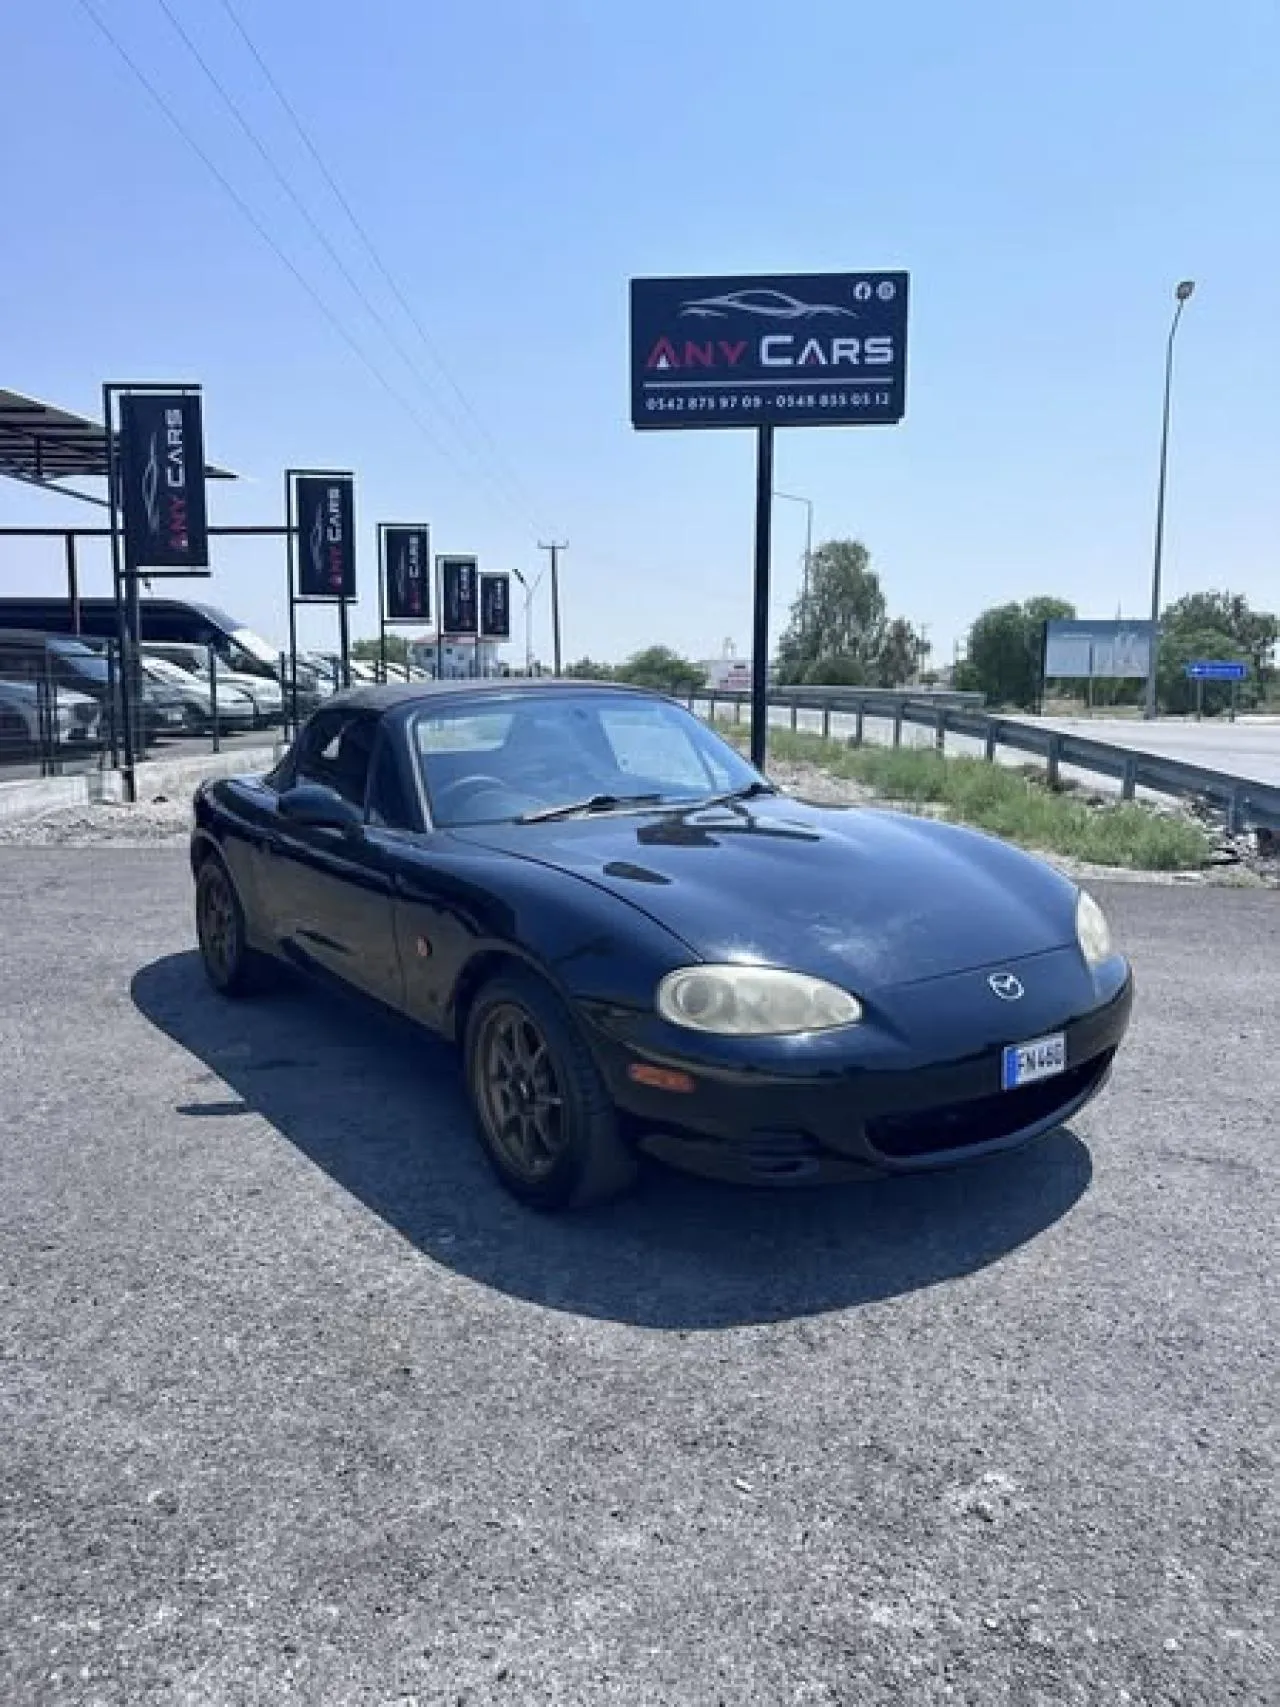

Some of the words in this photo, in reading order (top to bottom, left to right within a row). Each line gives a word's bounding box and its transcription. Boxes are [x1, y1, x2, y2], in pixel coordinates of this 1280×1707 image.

[646, 336, 748, 369] ANY
[760, 335, 894, 367] CARS
[166, 409, 185, 488] CARS
